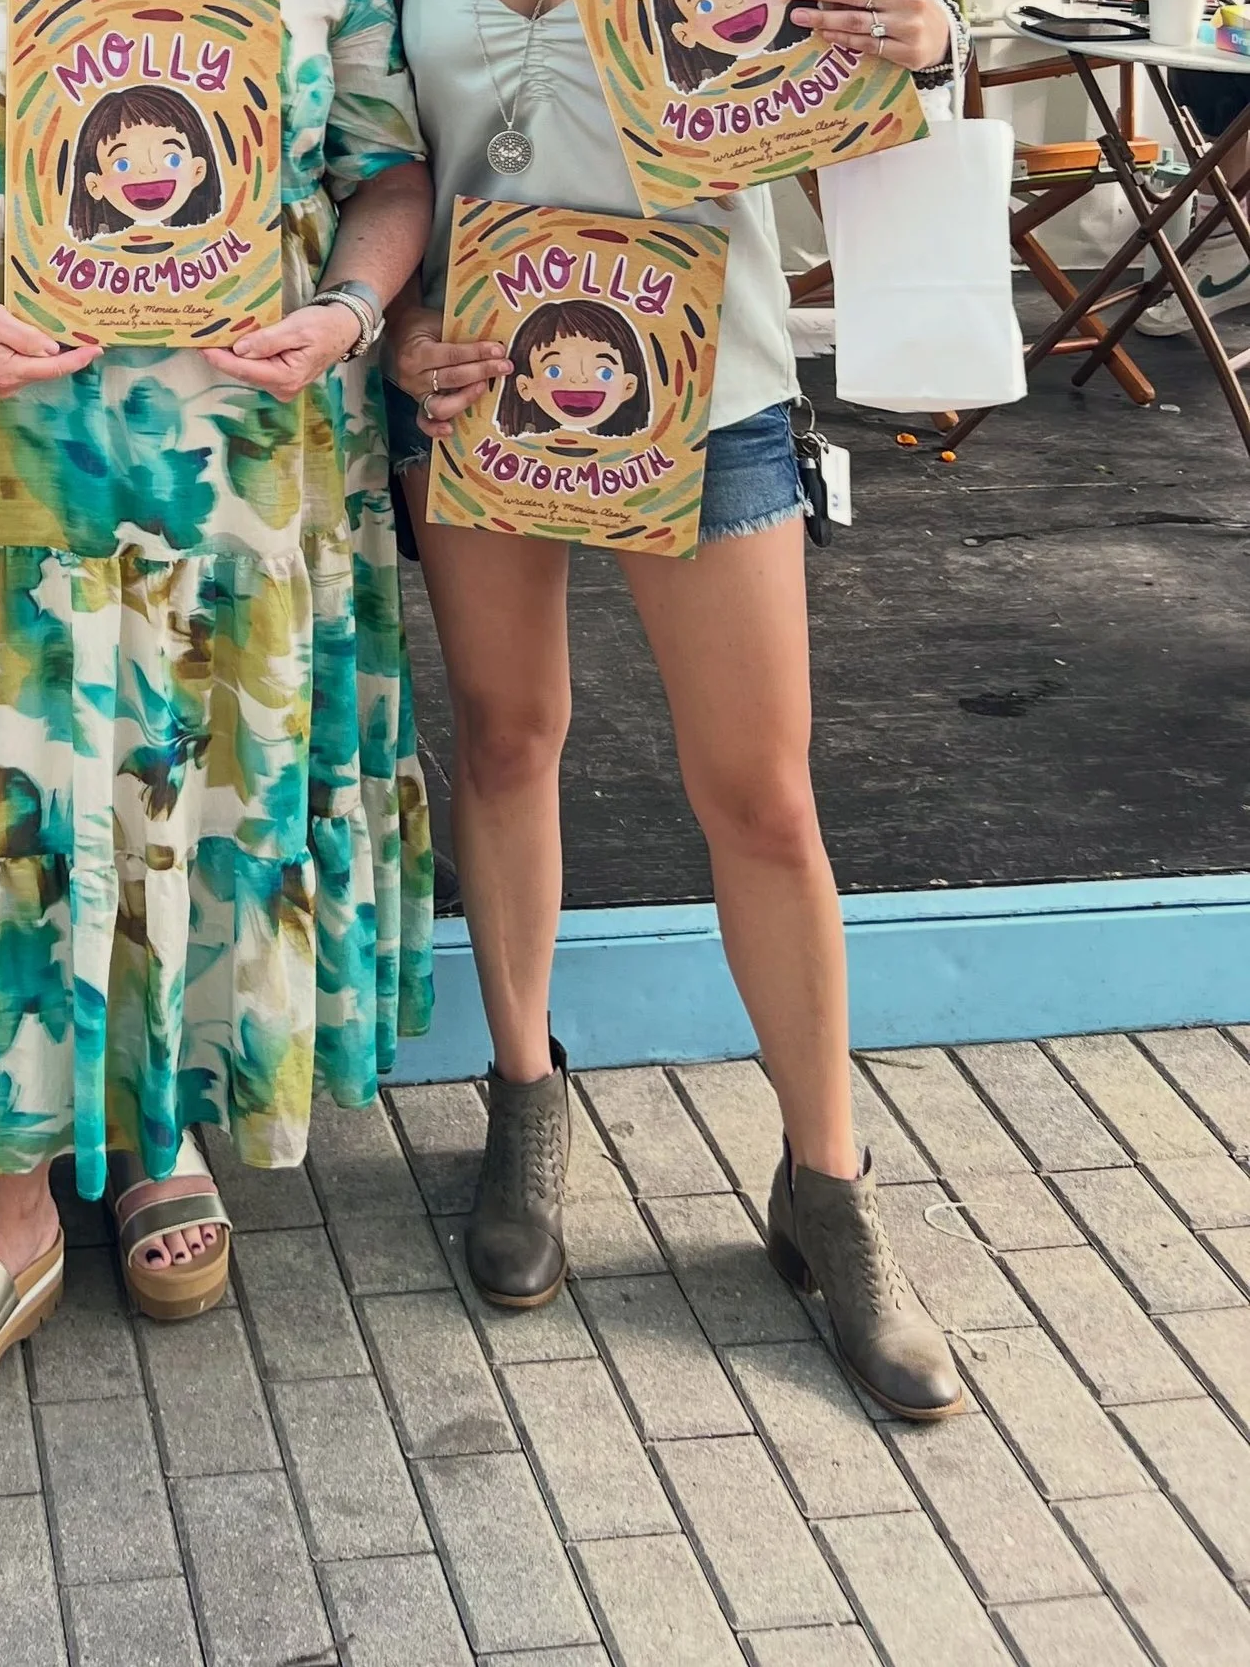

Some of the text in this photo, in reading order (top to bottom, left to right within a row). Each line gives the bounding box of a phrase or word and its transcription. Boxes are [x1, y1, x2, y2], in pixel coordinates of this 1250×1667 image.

[55, 33, 231, 102] MOLLY
[759, 138, 771, 153] by
[49, 230, 251, 293] MOTORMOUTH
[496, 246, 674, 315] MOLLY
[129, 304, 140, 319] by
[474, 437, 674, 496] MOTORMOUTH
[548, 500, 558, 515] by
